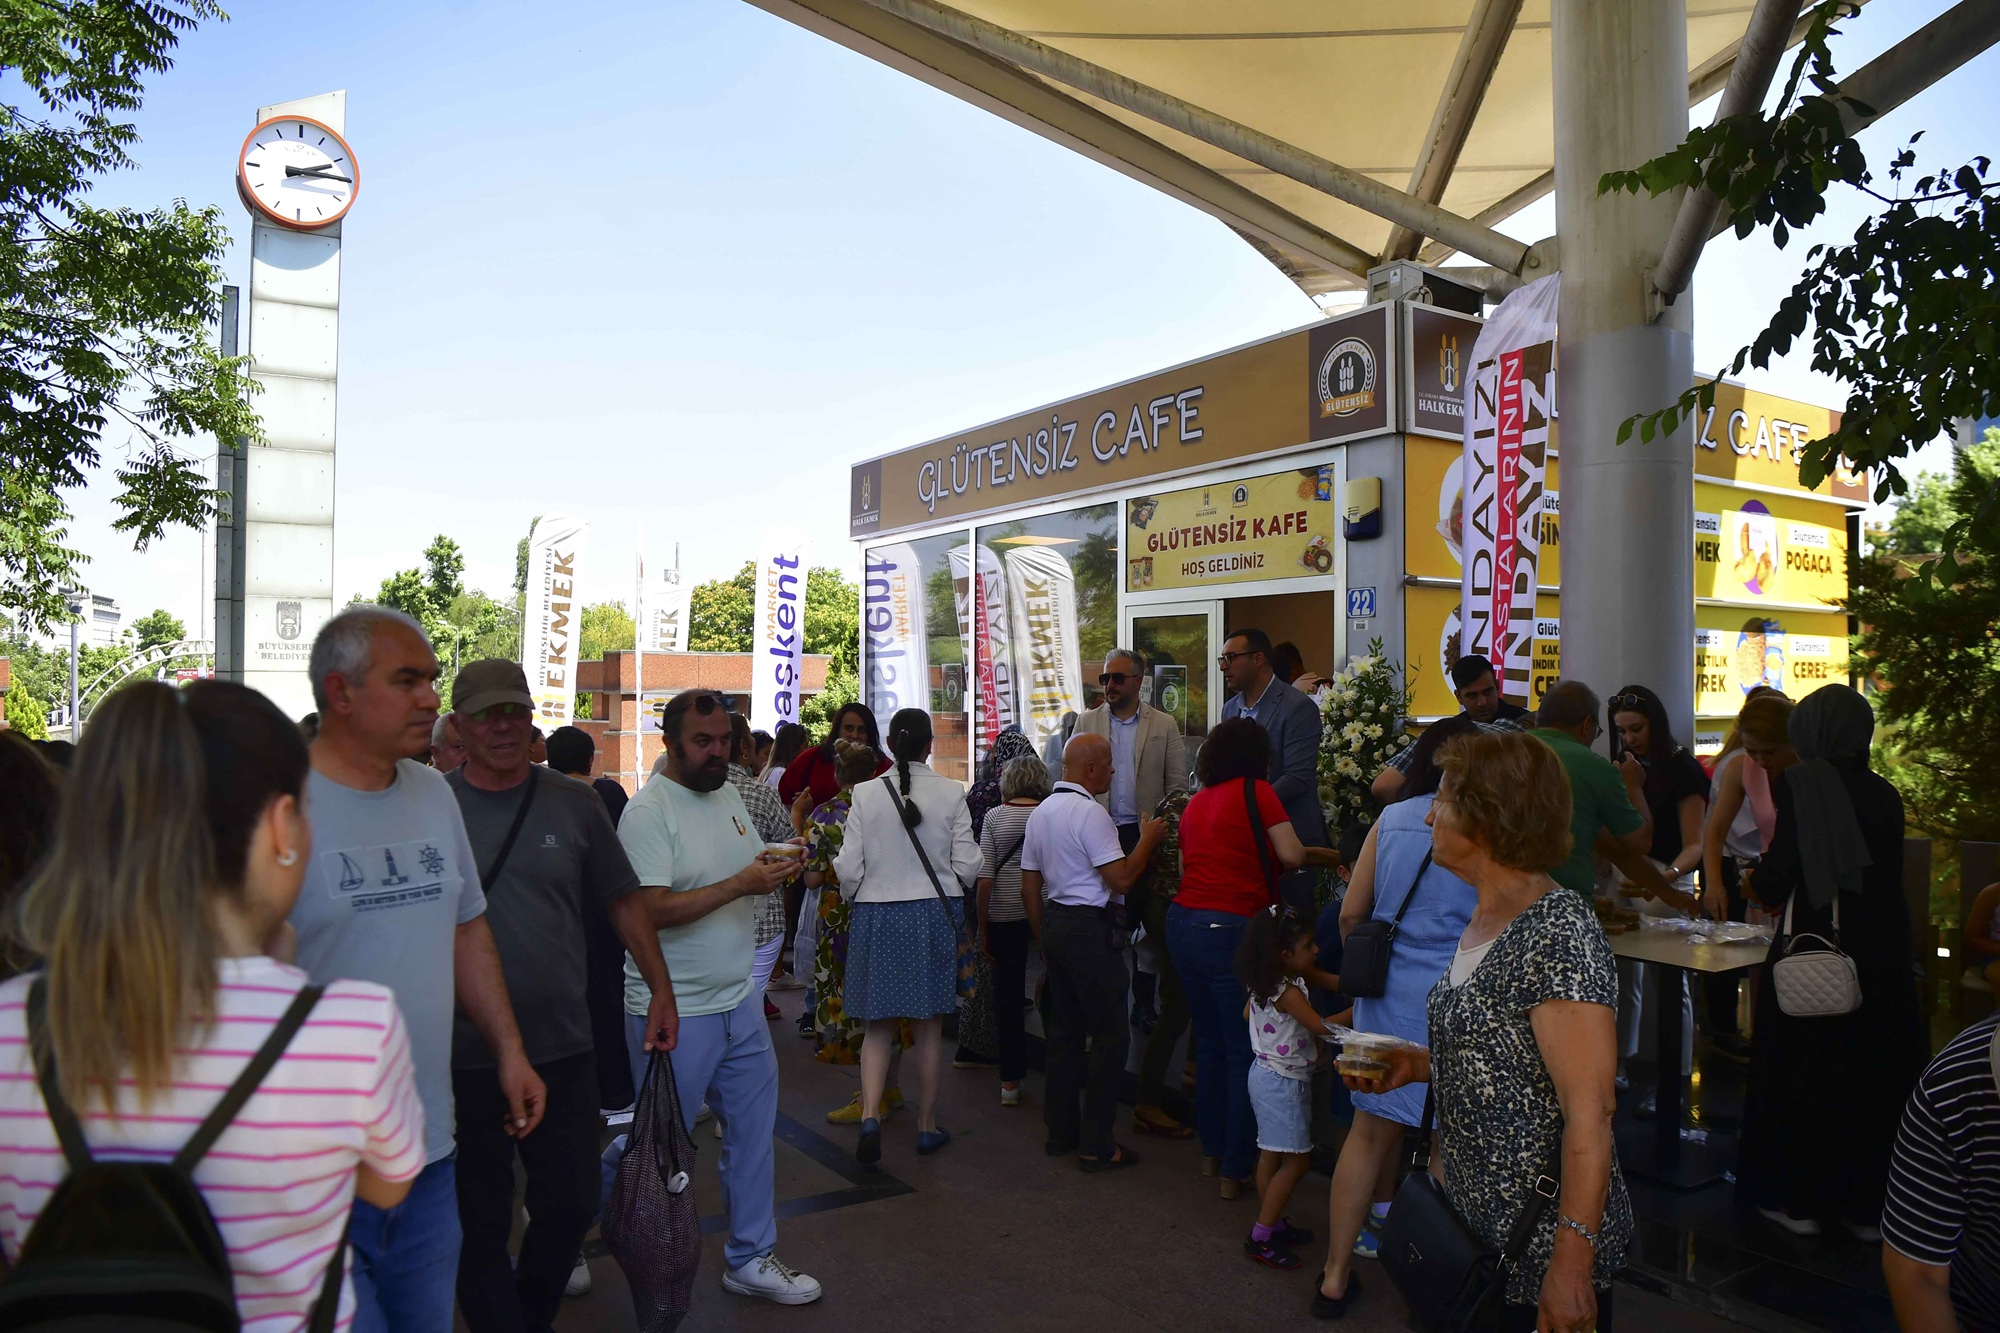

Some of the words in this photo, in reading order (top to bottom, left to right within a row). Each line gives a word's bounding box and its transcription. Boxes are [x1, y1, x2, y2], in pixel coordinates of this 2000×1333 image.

[1327, 347, 1345, 364] HALK
[1345, 344, 1366, 357] EKMEK
[1326, 394, 1369, 412] GLÜTENSİZ
[1418, 398, 1446, 414] HALK
[917, 414, 1079, 514] GLÜTENSİZ
[1091, 385, 1205, 462] CAFE
[1727, 408, 1809, 465] CAFE
[1147, 514, 1247, 552] GLÜTENSİZ
[1252, 510, 1307, 539] KAFE
[1181, 560, 1205, 577] HOŞ
[1208, 551, 1264, 573] GELDİNİZ
[1786, 548, 1832, 578] POĞAÇA
[543, 547, 553, 611] BELEDİYESİ
[767, 566, 779, 641] MARKET
[1352, 590, 1370, 615] 22
[546, 549, 575, 689] EKMEK
[539, 615, 549, 686] BÜYÜKŞEHİR
[1541, 645, 1560, 656] KAK
[1793, 661, 1828, 683] ÇEREZ
